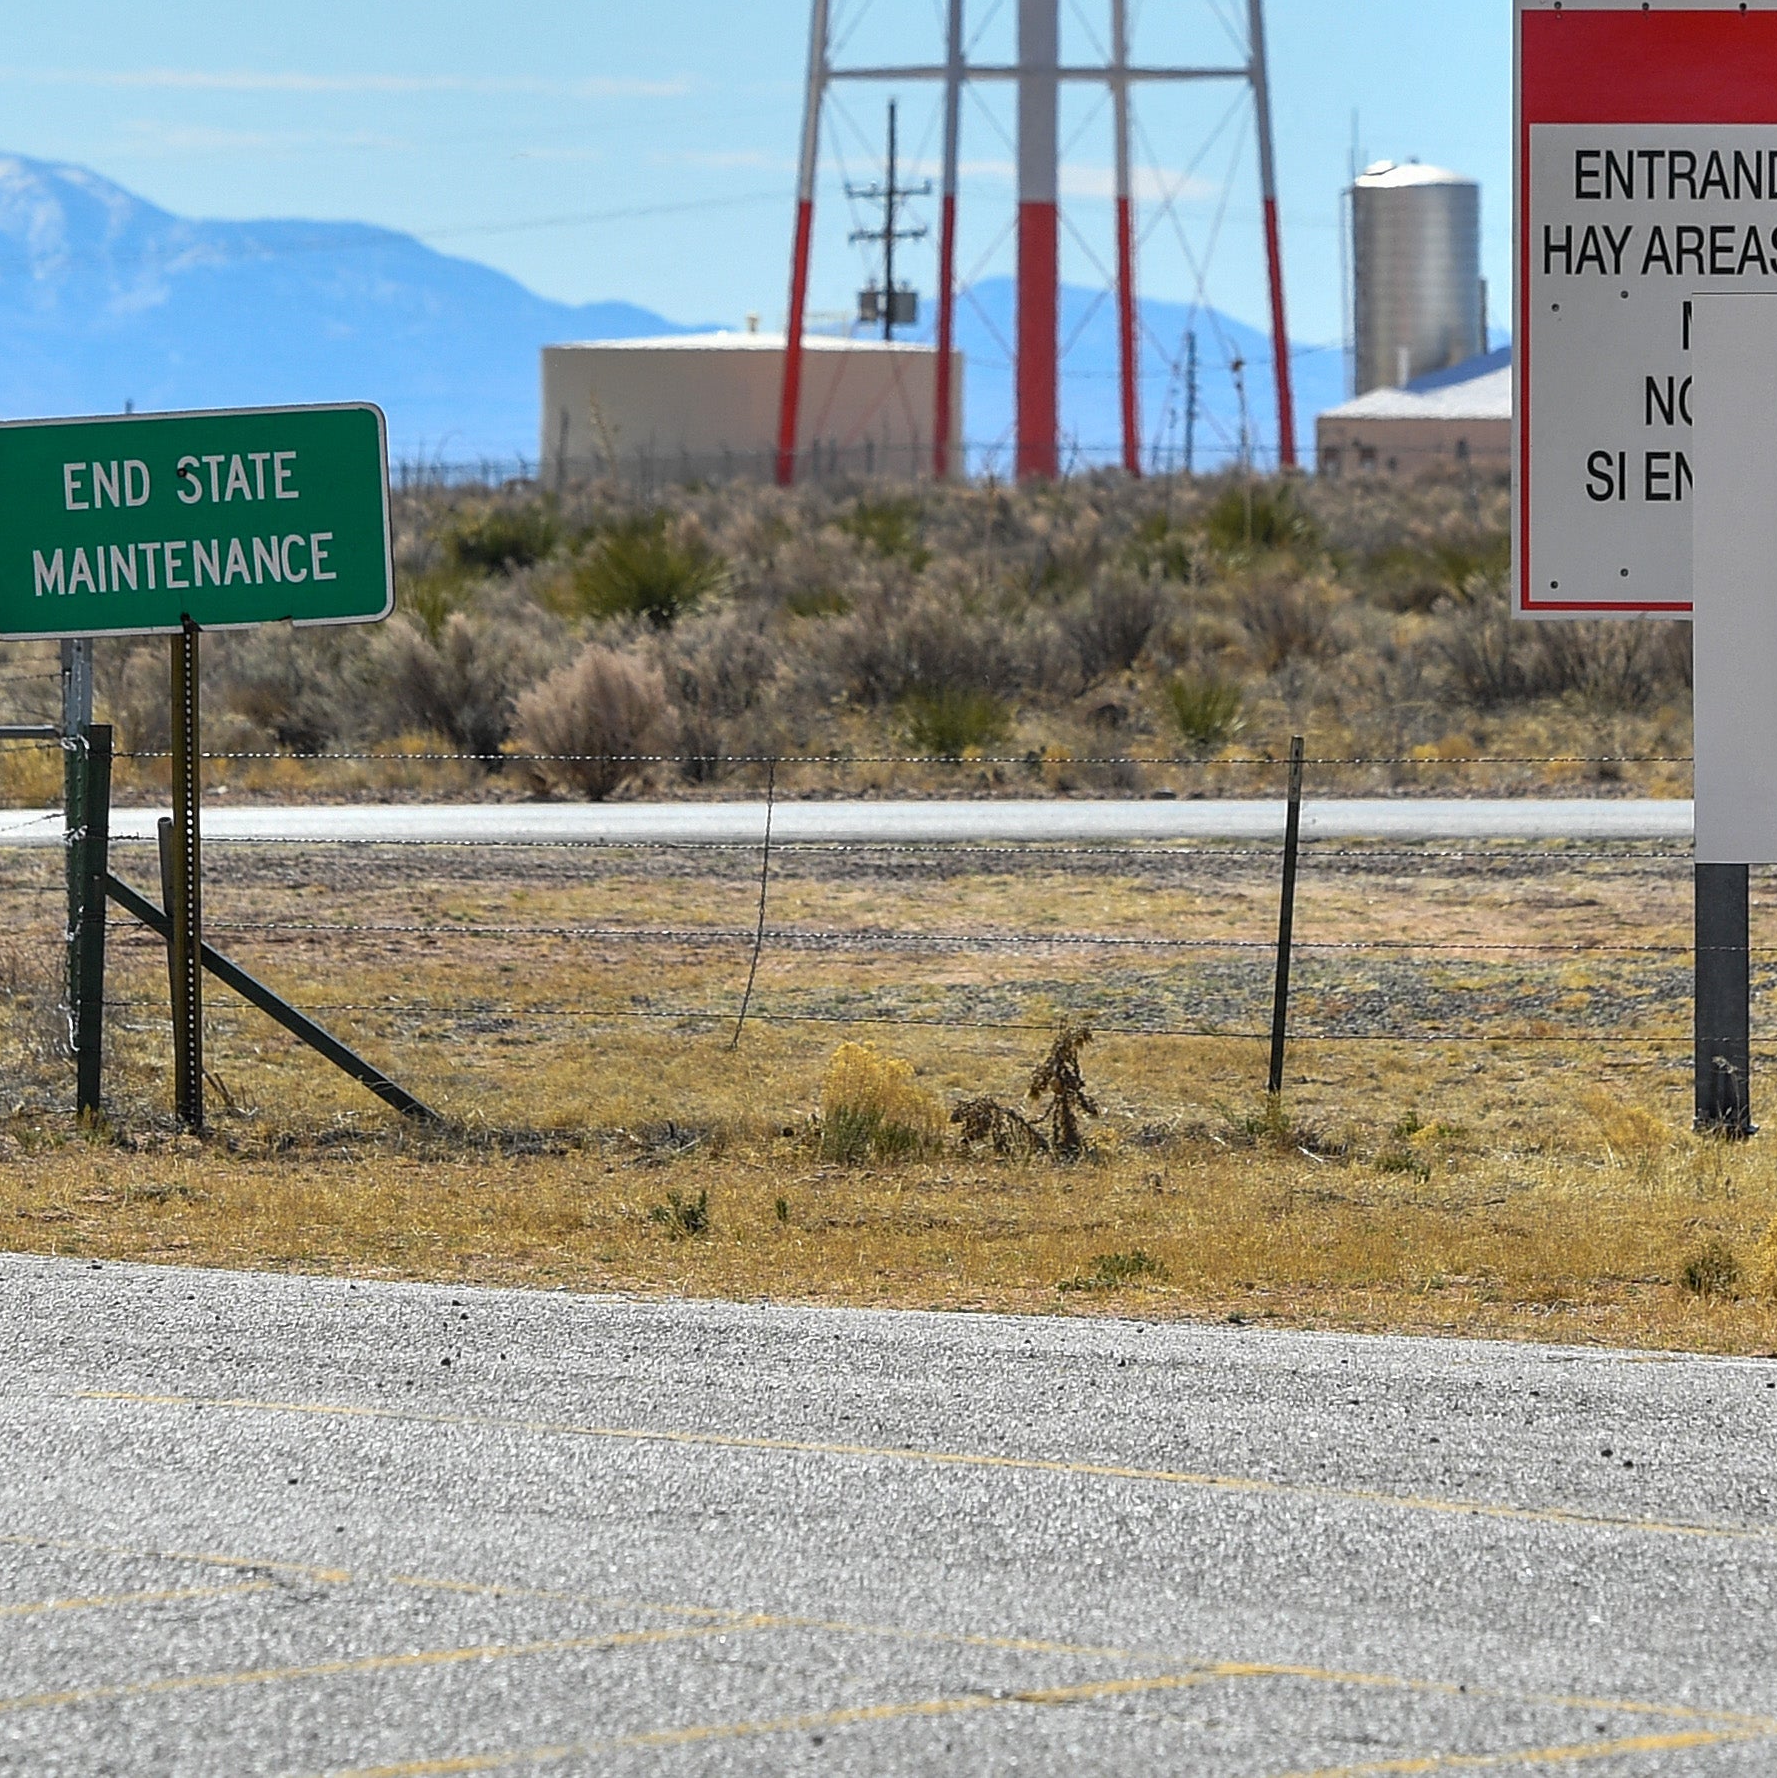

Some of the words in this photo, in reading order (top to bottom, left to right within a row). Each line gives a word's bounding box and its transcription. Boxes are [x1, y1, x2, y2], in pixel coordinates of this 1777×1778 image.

[1543, 224, 1633, 275] HAY
[63, 459, 150, 511] END
[177, 450, 299, 504] STATE
[1585, 450, 1626, 502] SI
[32, 531, 337, 597] MAINTENANCE
